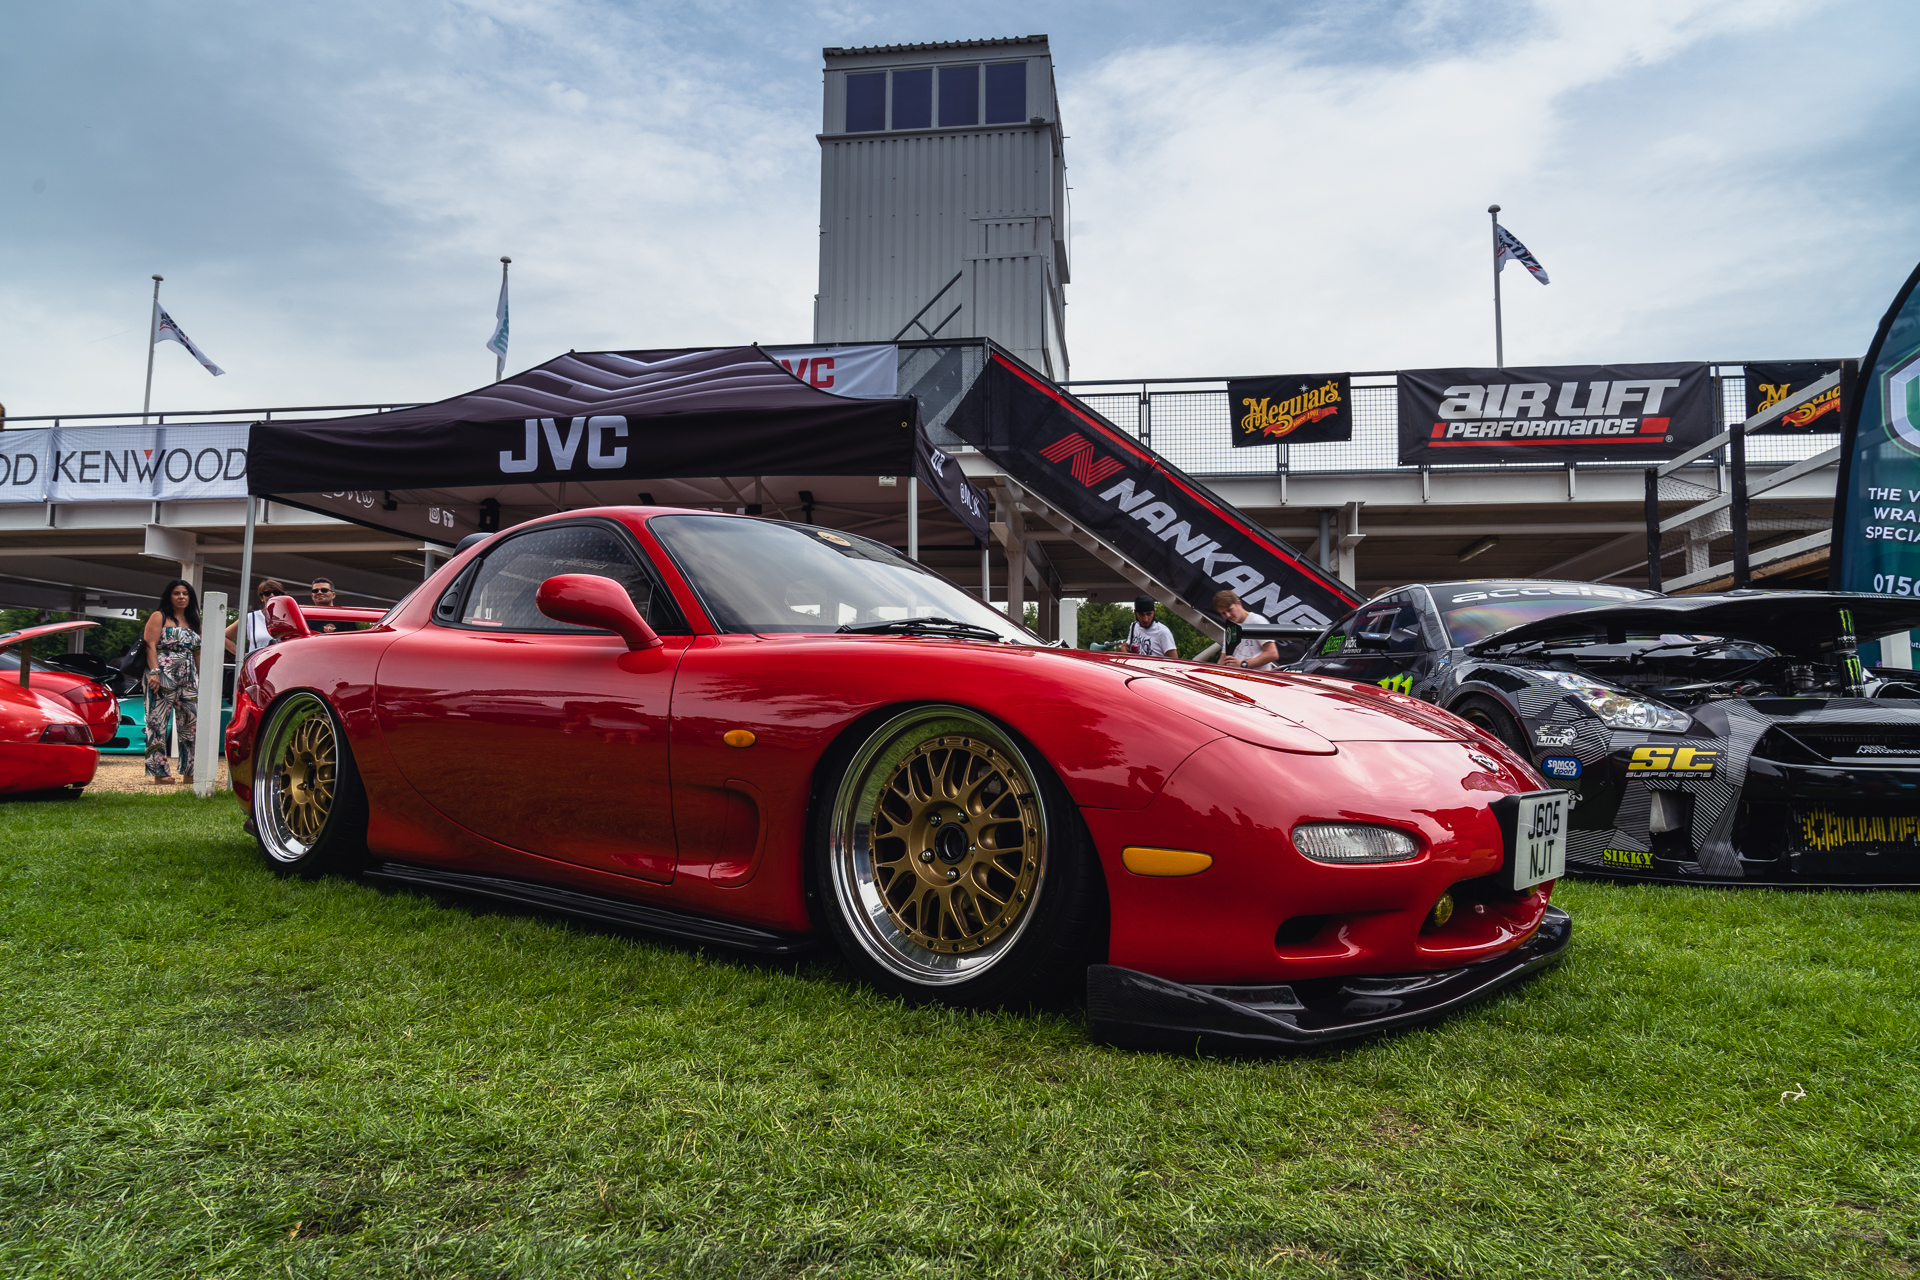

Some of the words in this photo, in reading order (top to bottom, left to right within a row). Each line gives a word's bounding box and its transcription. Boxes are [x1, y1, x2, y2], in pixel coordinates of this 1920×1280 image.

[776, 357, 835, 388] VC
[1241, 380, 1340, 434] Meguiar's
[1555, 379, 1681, 416] LIFT
[1292, 415, 1306, 428] since
[1307, 409, 1319, 419] 1901
[499, 415, 629, 473] JVC
[52, 447, 248, 484] KENWOOD
[1868, 487, 1902, 501] THE
[1099, 478, 1332, 625] NANKANG
[1547, 759, 1576, 769] SAMCO
[1554, 768, 1575, 776] sport
[1528, 801, 1561, 840] J605
[1802, 809, 1920, 851] QUAIF
[1529, 840, 1555, 879] NJT
[1603, 849, 1653, 865] SIKKY
